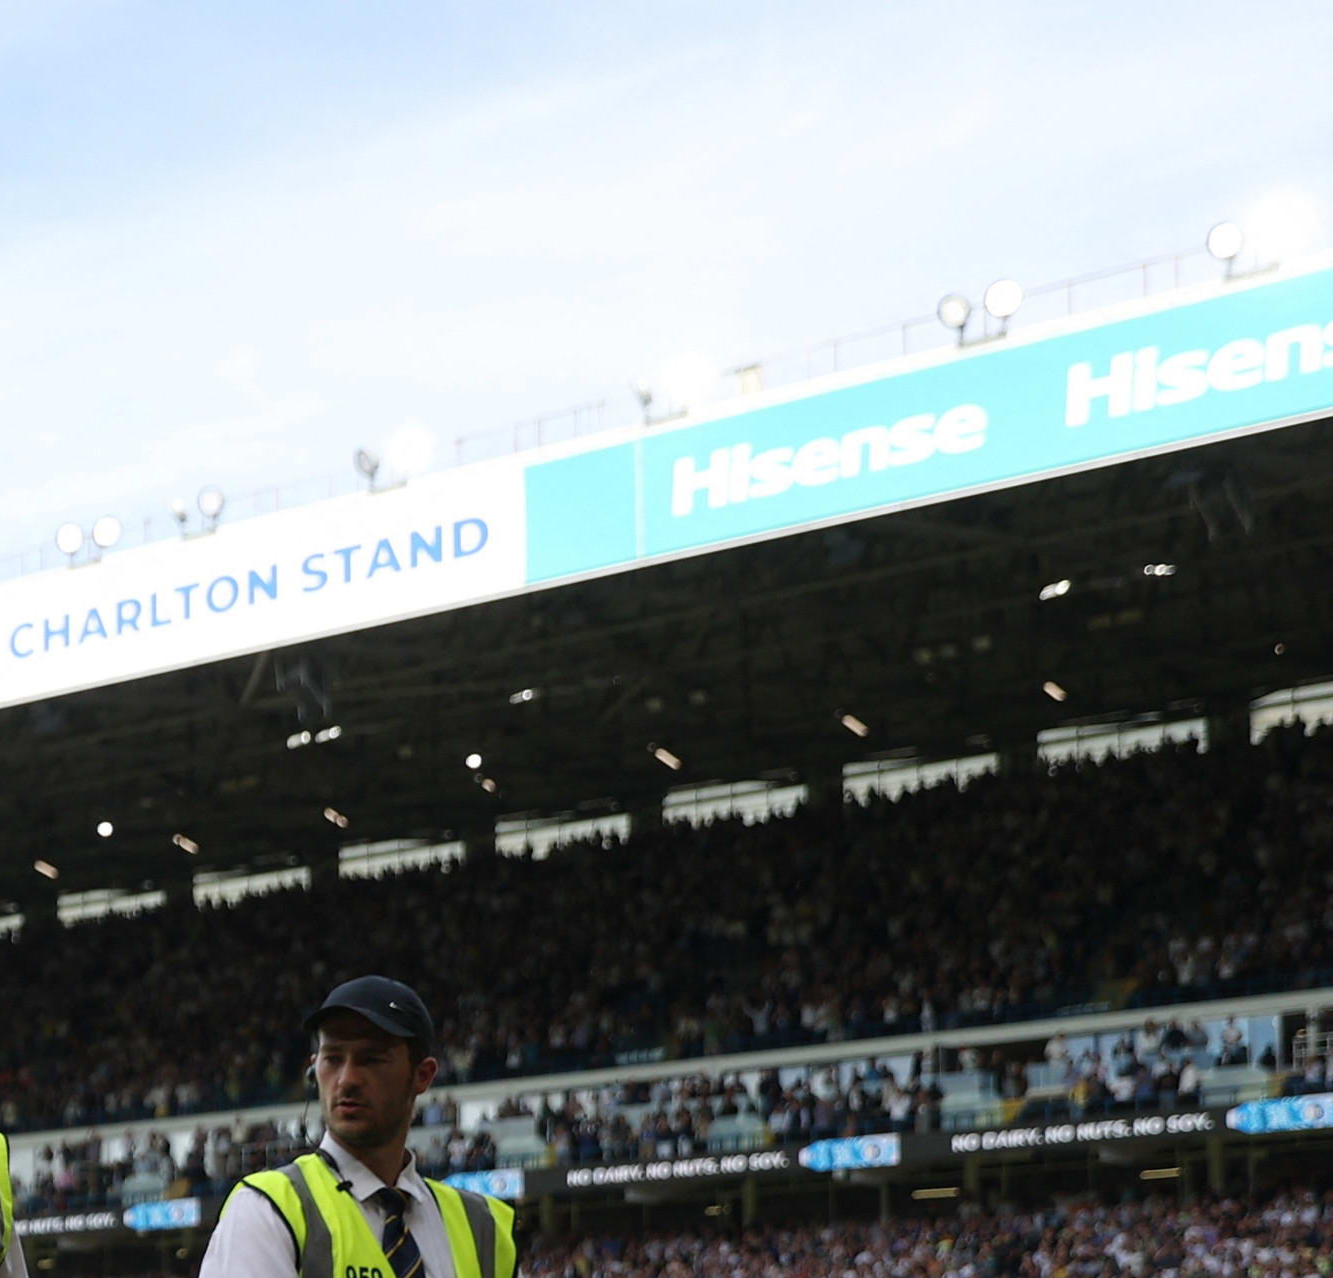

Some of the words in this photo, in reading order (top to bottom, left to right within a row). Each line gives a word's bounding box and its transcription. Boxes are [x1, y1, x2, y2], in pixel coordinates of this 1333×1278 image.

[671, 403, 989, 517] Hisense
[9, 564, 278, 659] CHARLTON
[301, 517, 490, 593] STAND
